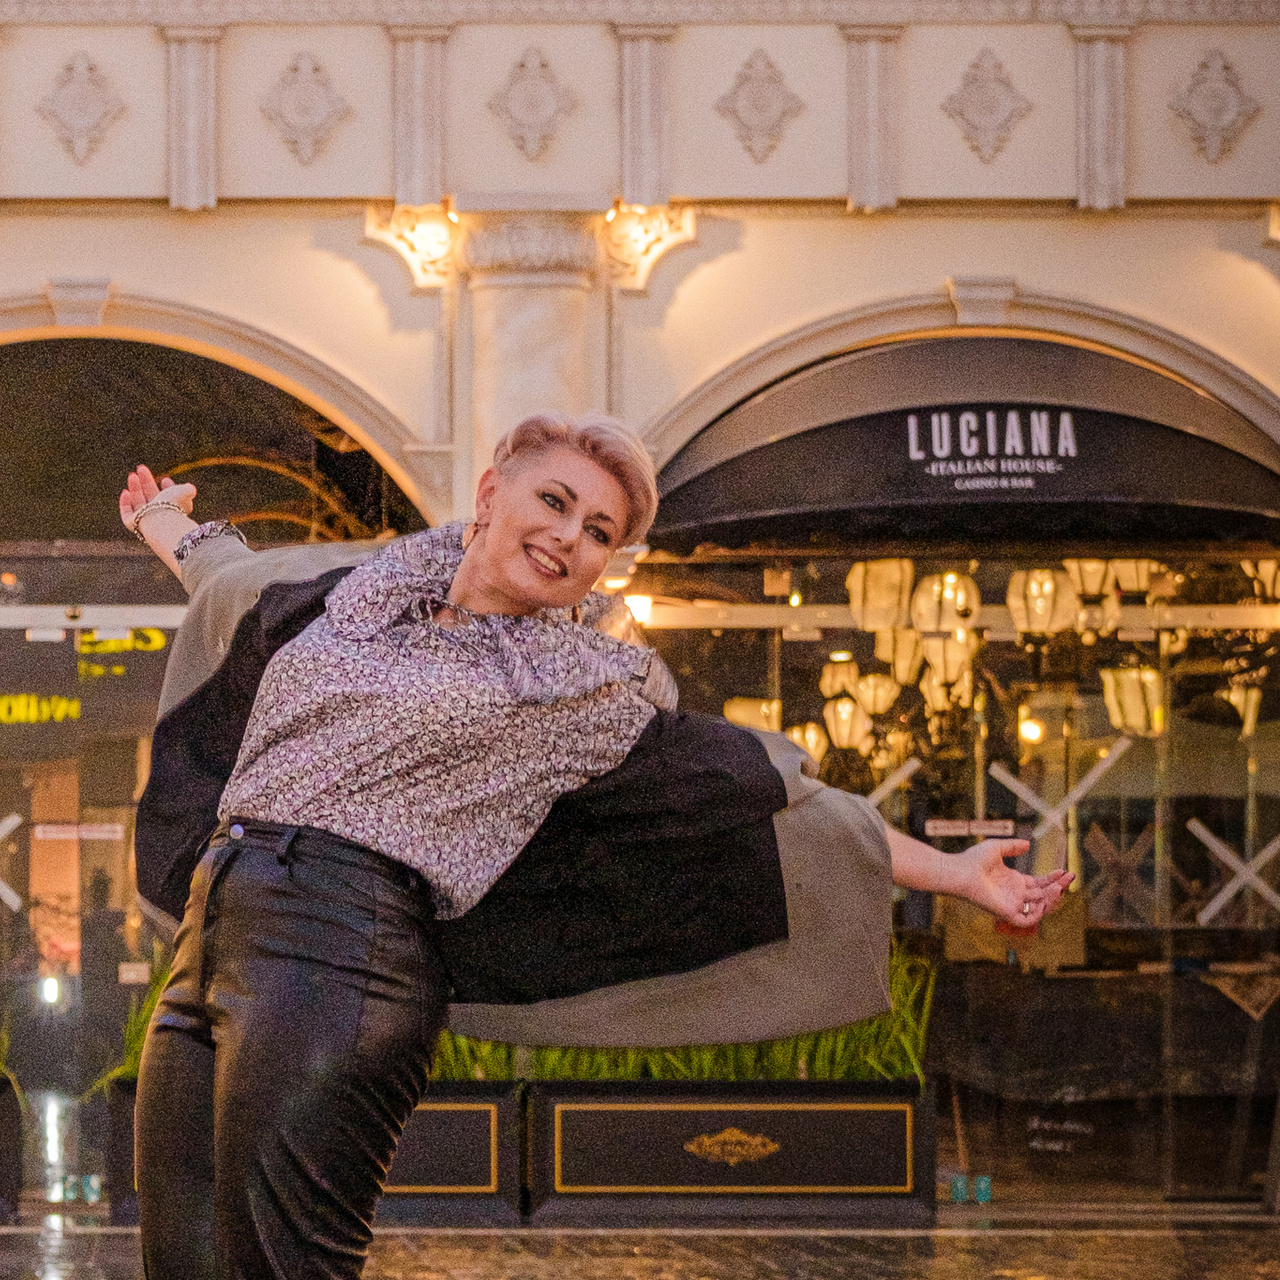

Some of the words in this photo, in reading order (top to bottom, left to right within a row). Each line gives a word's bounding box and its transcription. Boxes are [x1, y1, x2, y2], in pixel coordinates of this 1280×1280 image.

[907, 410, 1079, 461] LUCIANA
[930, 459, 997, 476] ITALIAN
[1000, 459, 1056, 474] HOUSE
